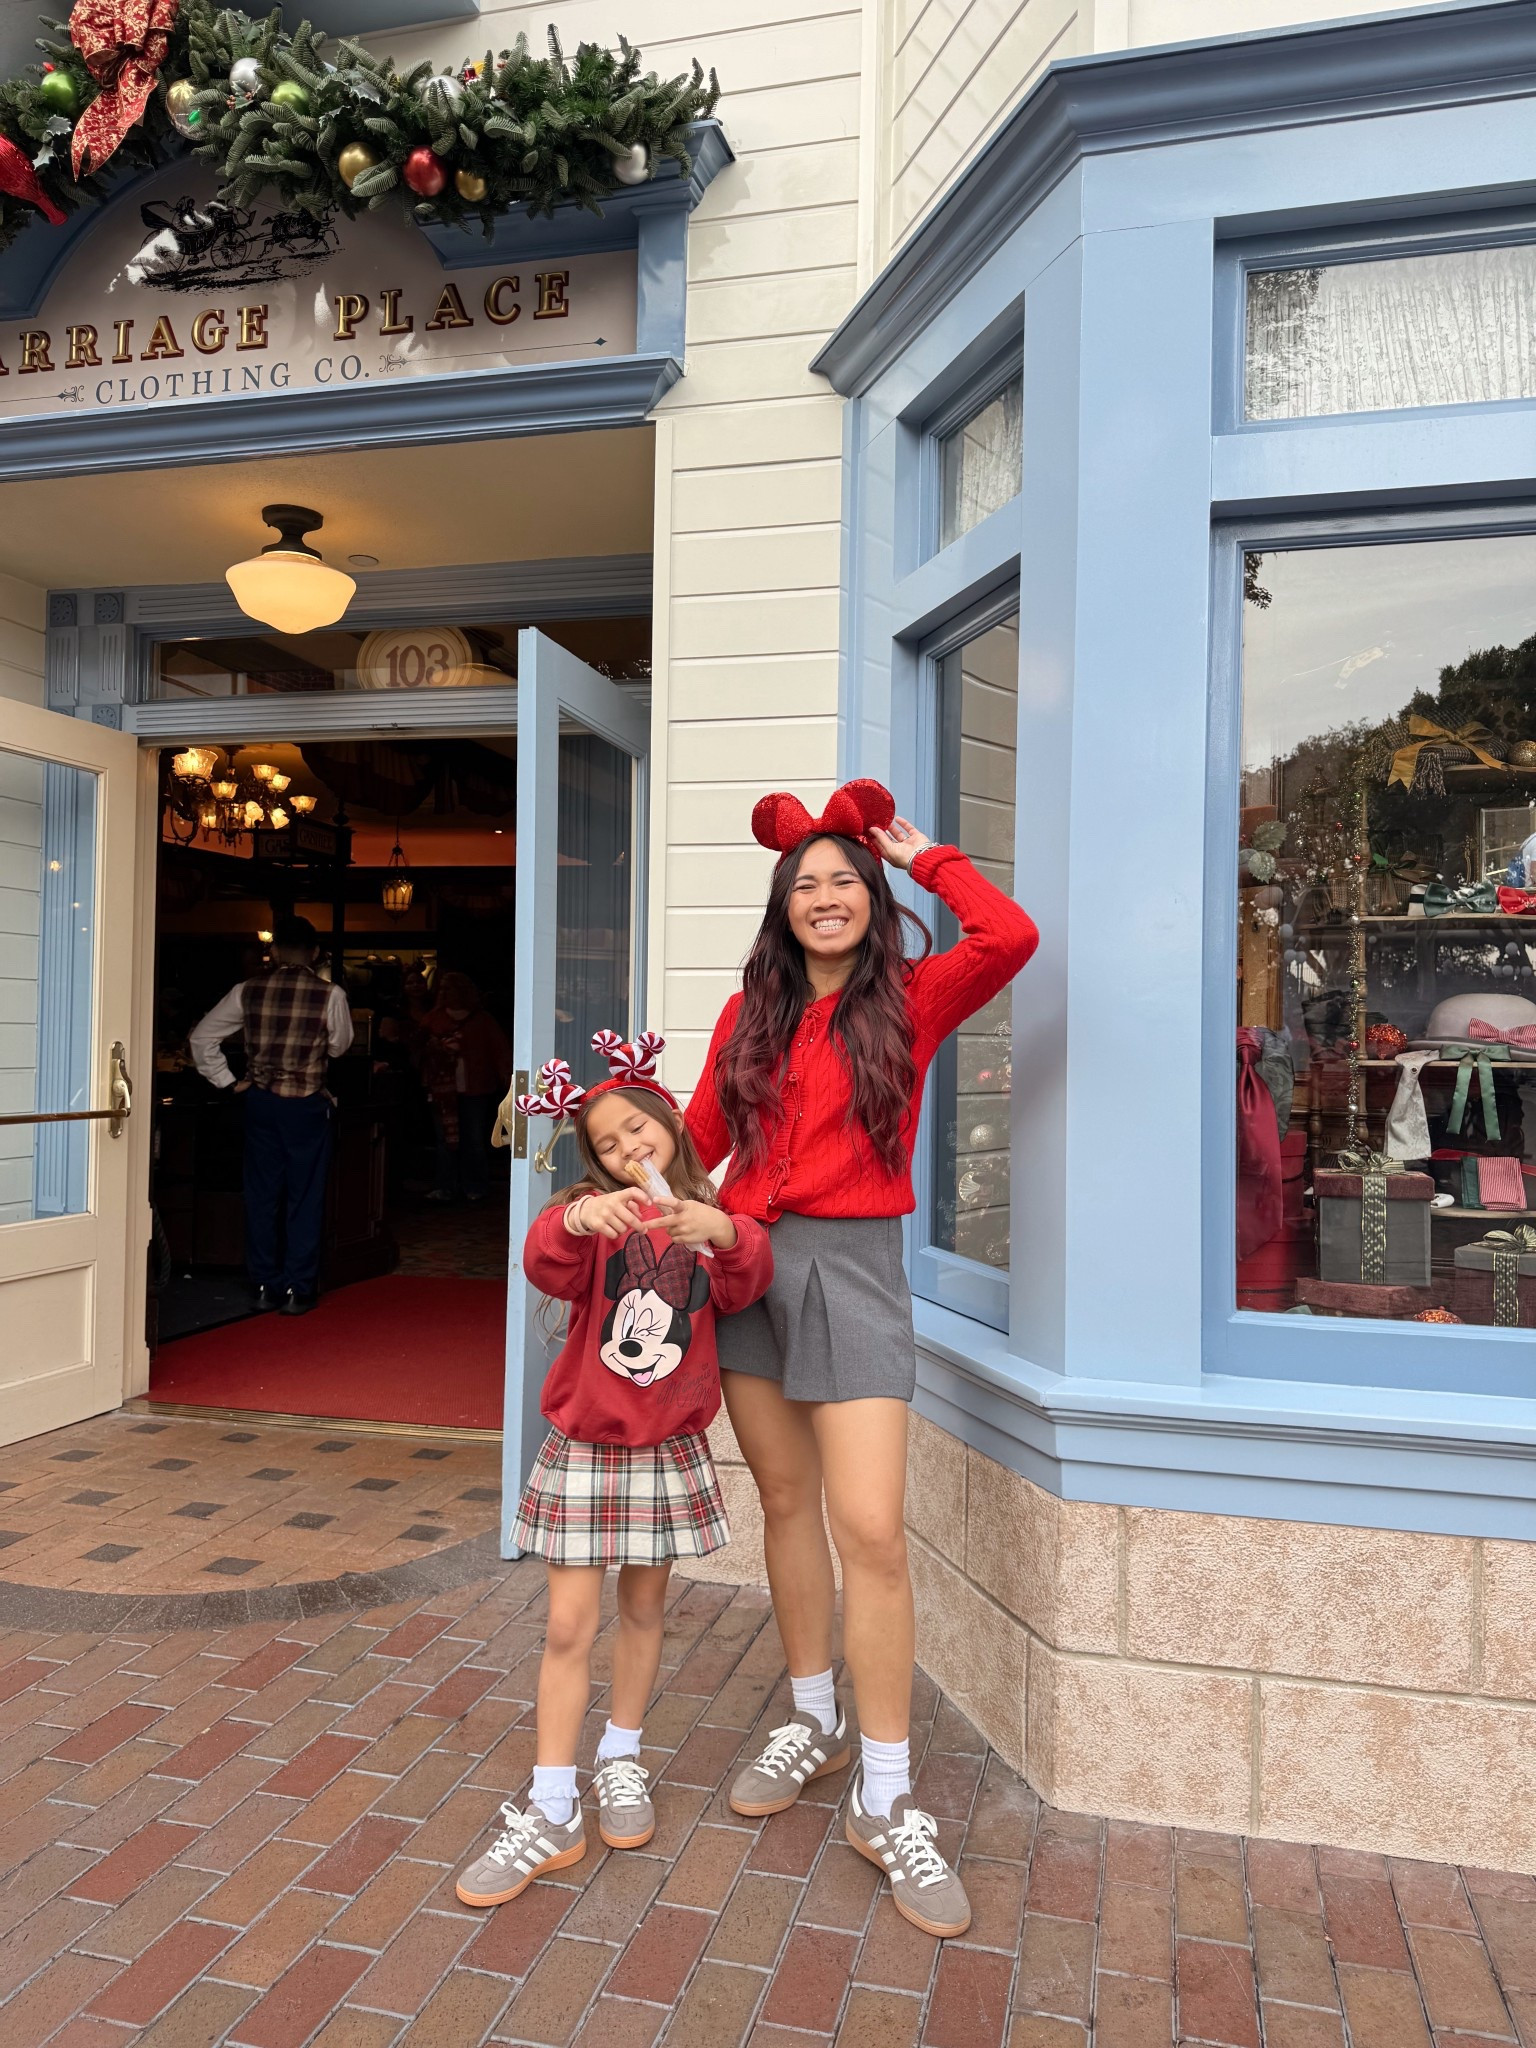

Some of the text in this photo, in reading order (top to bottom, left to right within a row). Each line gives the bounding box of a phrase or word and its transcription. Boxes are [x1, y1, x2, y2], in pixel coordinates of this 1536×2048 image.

[0, 270, 570, 377] RRIAGE PLACE
[96, 353, 371, 405] CLOTHING CO.
[385, 643, 450, 688] 103
